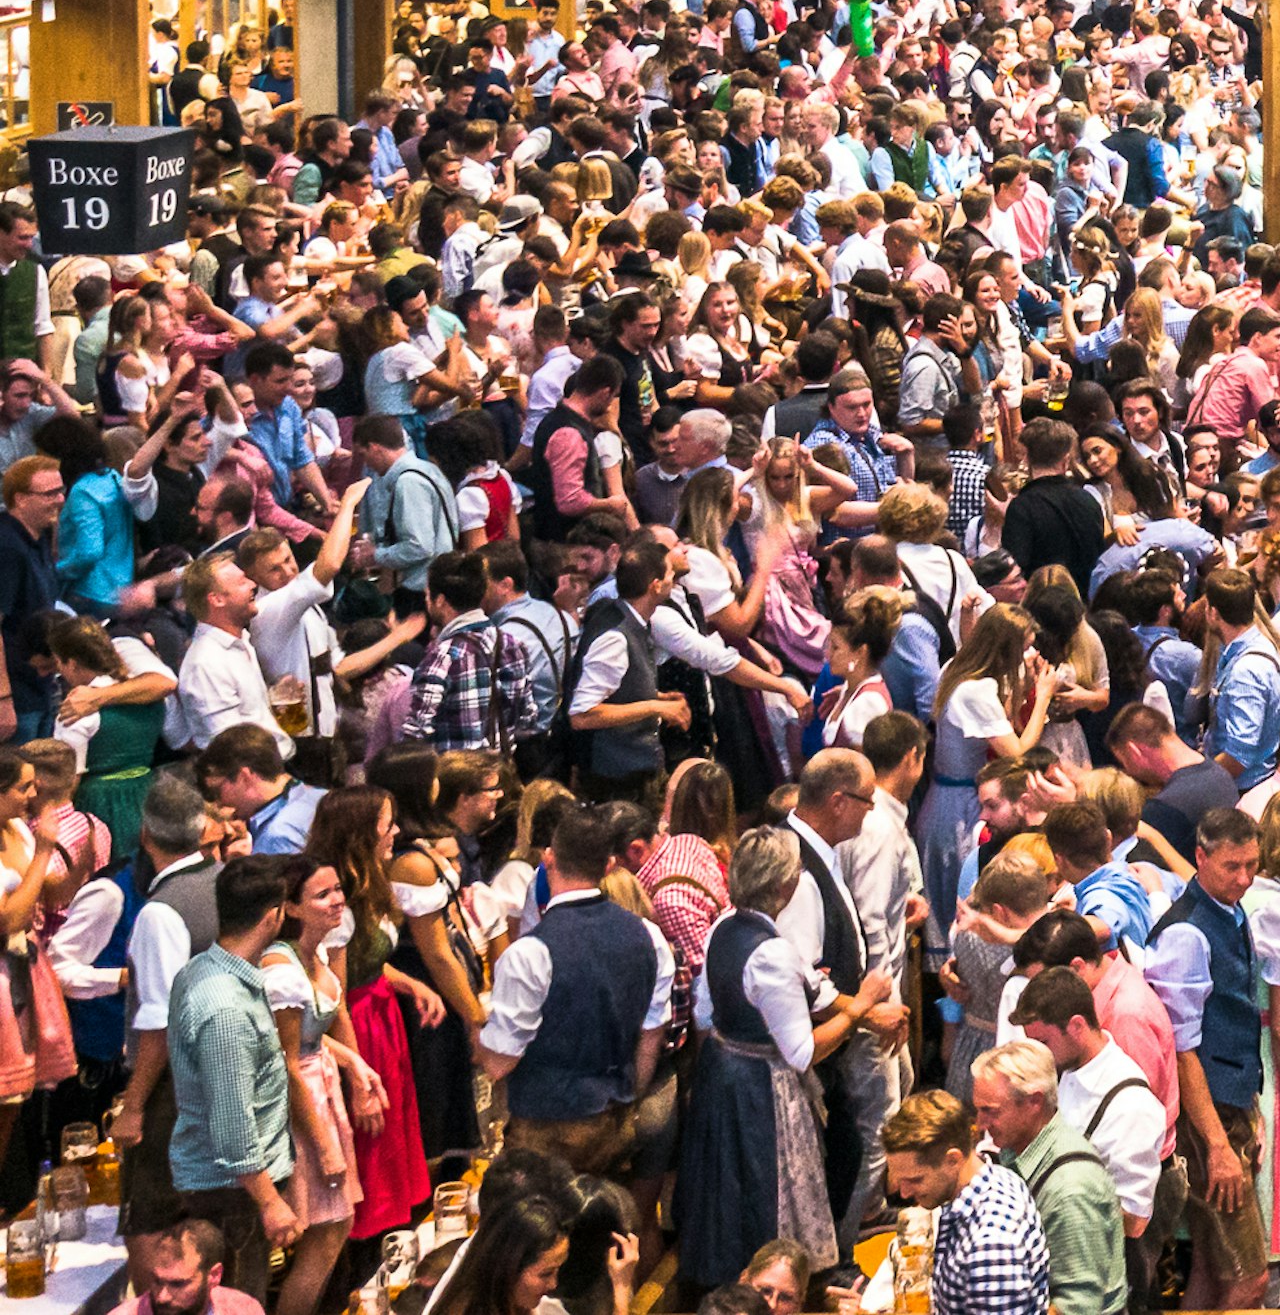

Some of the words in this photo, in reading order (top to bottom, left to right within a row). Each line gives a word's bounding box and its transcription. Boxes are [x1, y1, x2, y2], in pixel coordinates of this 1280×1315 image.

[49, 158, 119, 186] Boxe
[146, 155, 186, 185] Boxe
[61, 196, 110, 230] 19
[148, 188, 177, 227] 19
